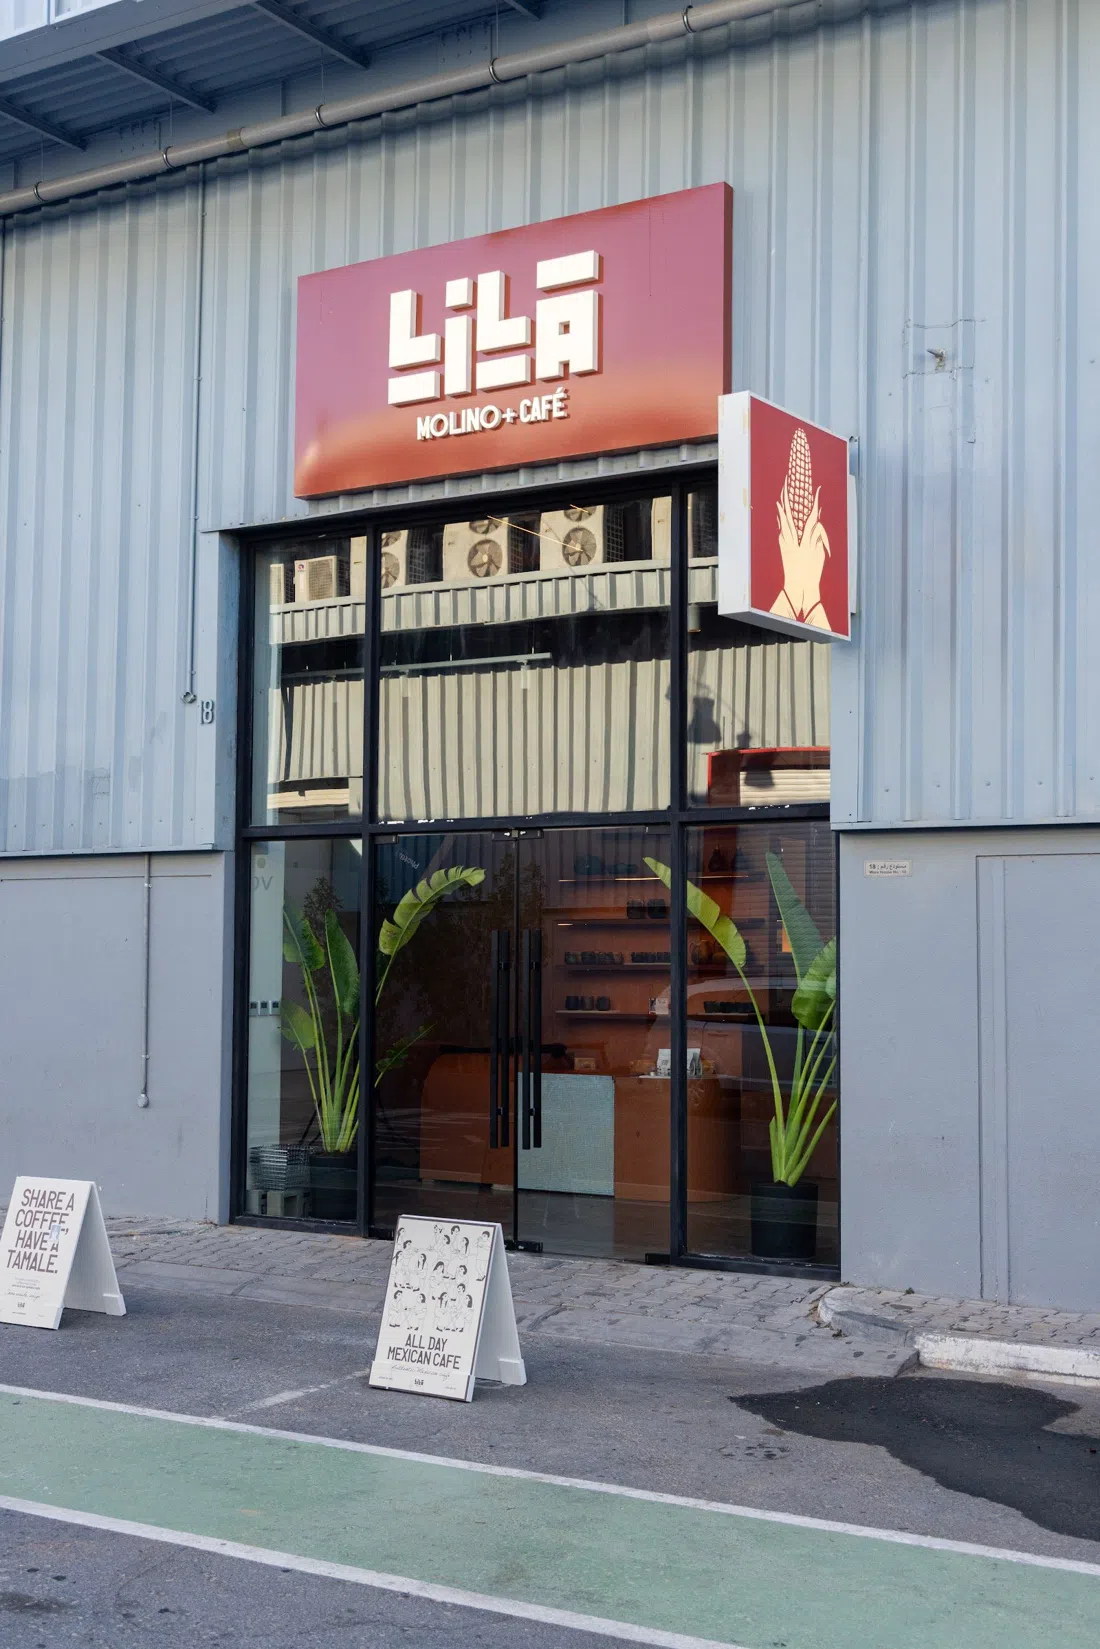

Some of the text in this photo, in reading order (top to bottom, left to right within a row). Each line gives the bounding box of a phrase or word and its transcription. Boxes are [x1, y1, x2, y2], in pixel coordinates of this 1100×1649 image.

[21, 1188, 75, 1211] SHARE A
[15, 1229, 50, 1251] HAVE
[7, 1249, 58, 1274] TAMALE.
[405, 1333, 448, 1352] ALL DAY
[387, 1346, 461, 1370] MEXICAN CAFE
